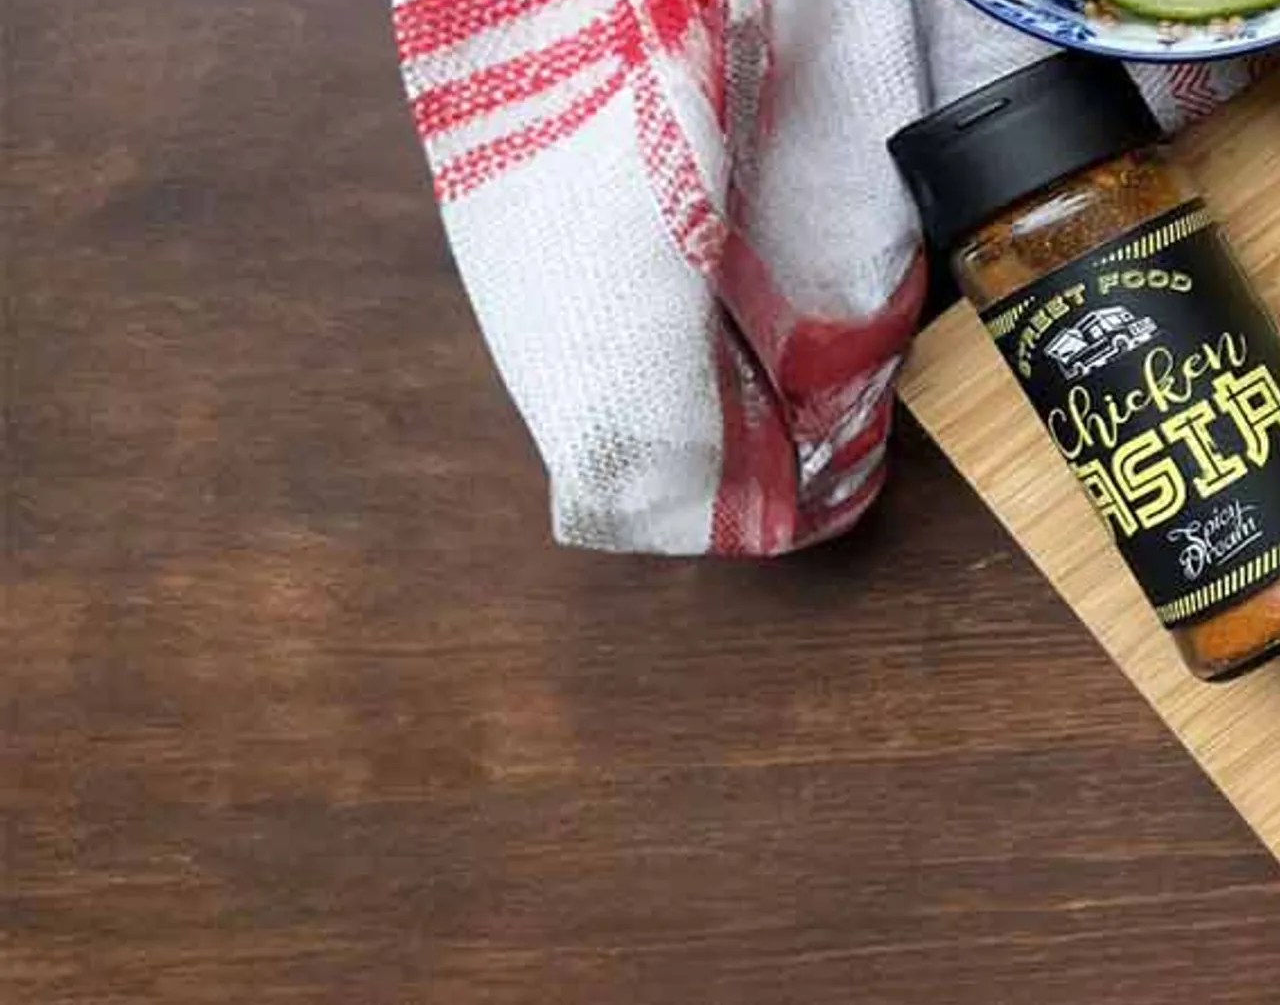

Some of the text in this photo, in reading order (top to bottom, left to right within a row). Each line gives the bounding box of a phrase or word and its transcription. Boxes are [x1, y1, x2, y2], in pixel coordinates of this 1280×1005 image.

[1097, 268, 1193, 295] FOOD
[1048, 332, 1248, 459] Chicken
[1166, 499, 1259, 552] Spicy
[1179, 516, 1258, 579] Dream
